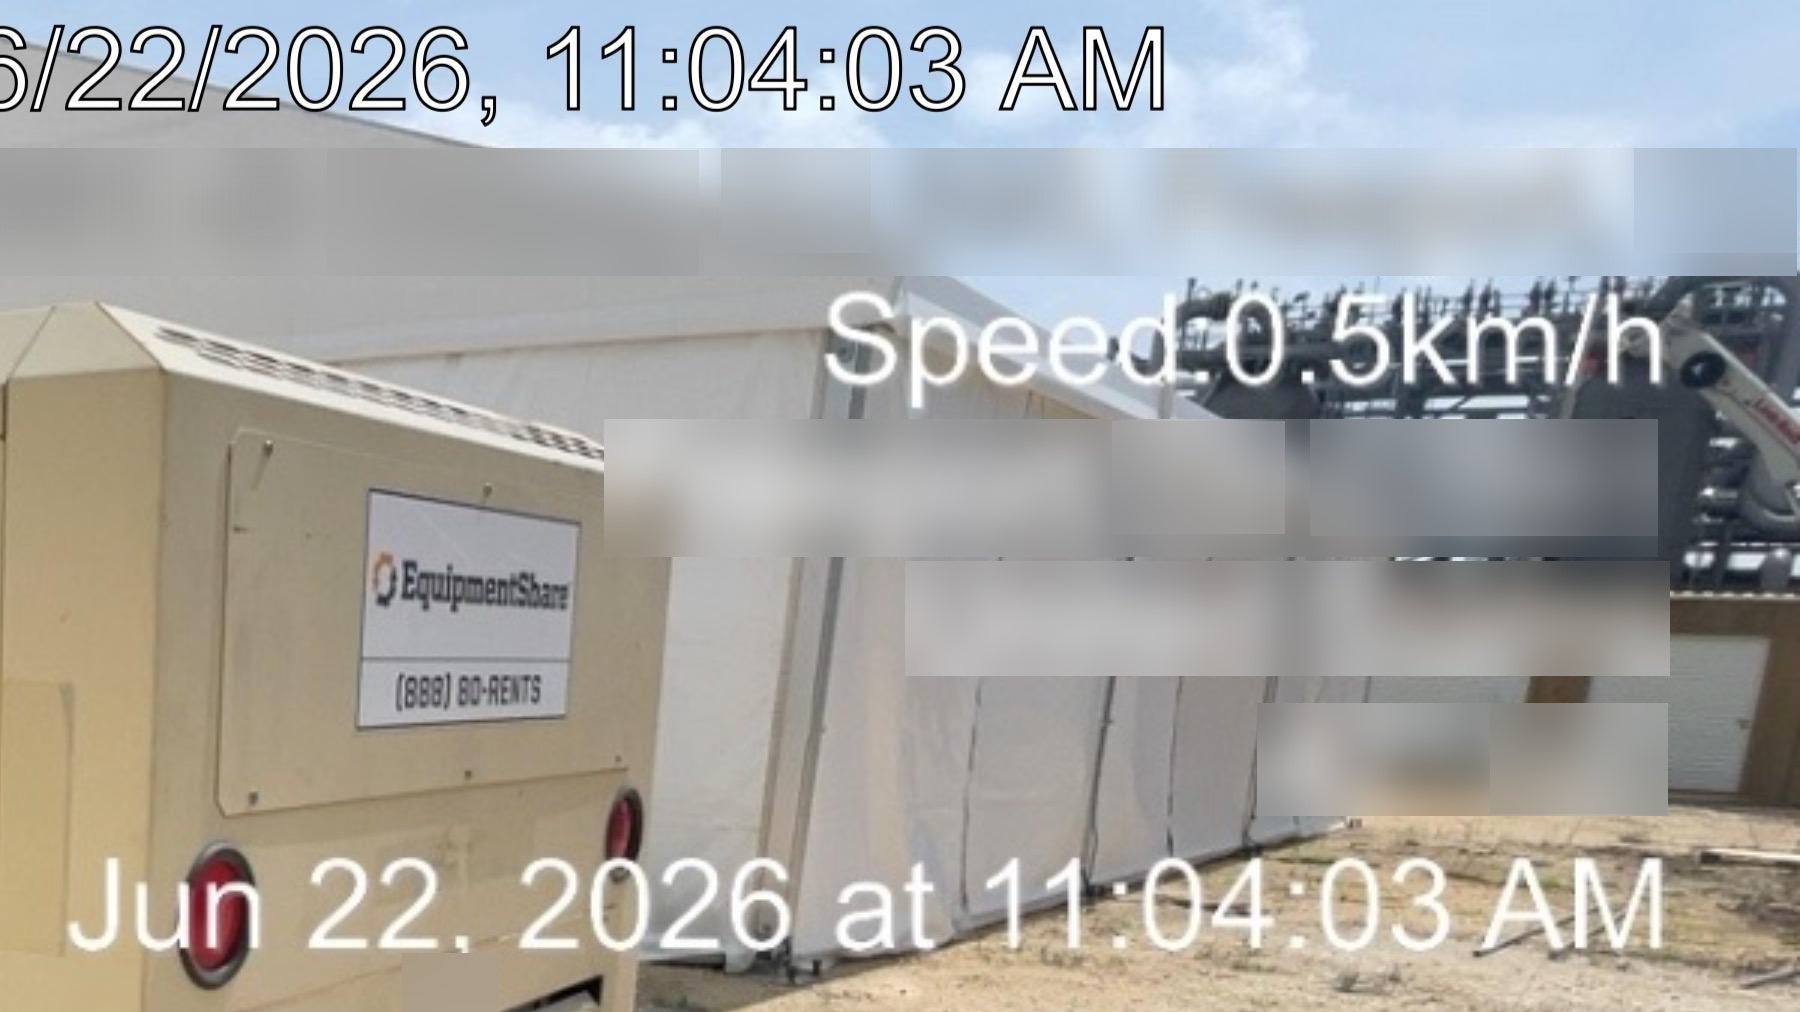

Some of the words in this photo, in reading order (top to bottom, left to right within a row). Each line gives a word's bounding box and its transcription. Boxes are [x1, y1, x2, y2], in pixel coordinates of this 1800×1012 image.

[401, 559, 568, 613] EquipmentShare
[396, 672, 451, 712] (888)
[458, 674, 542, 706] 80-RENTS
